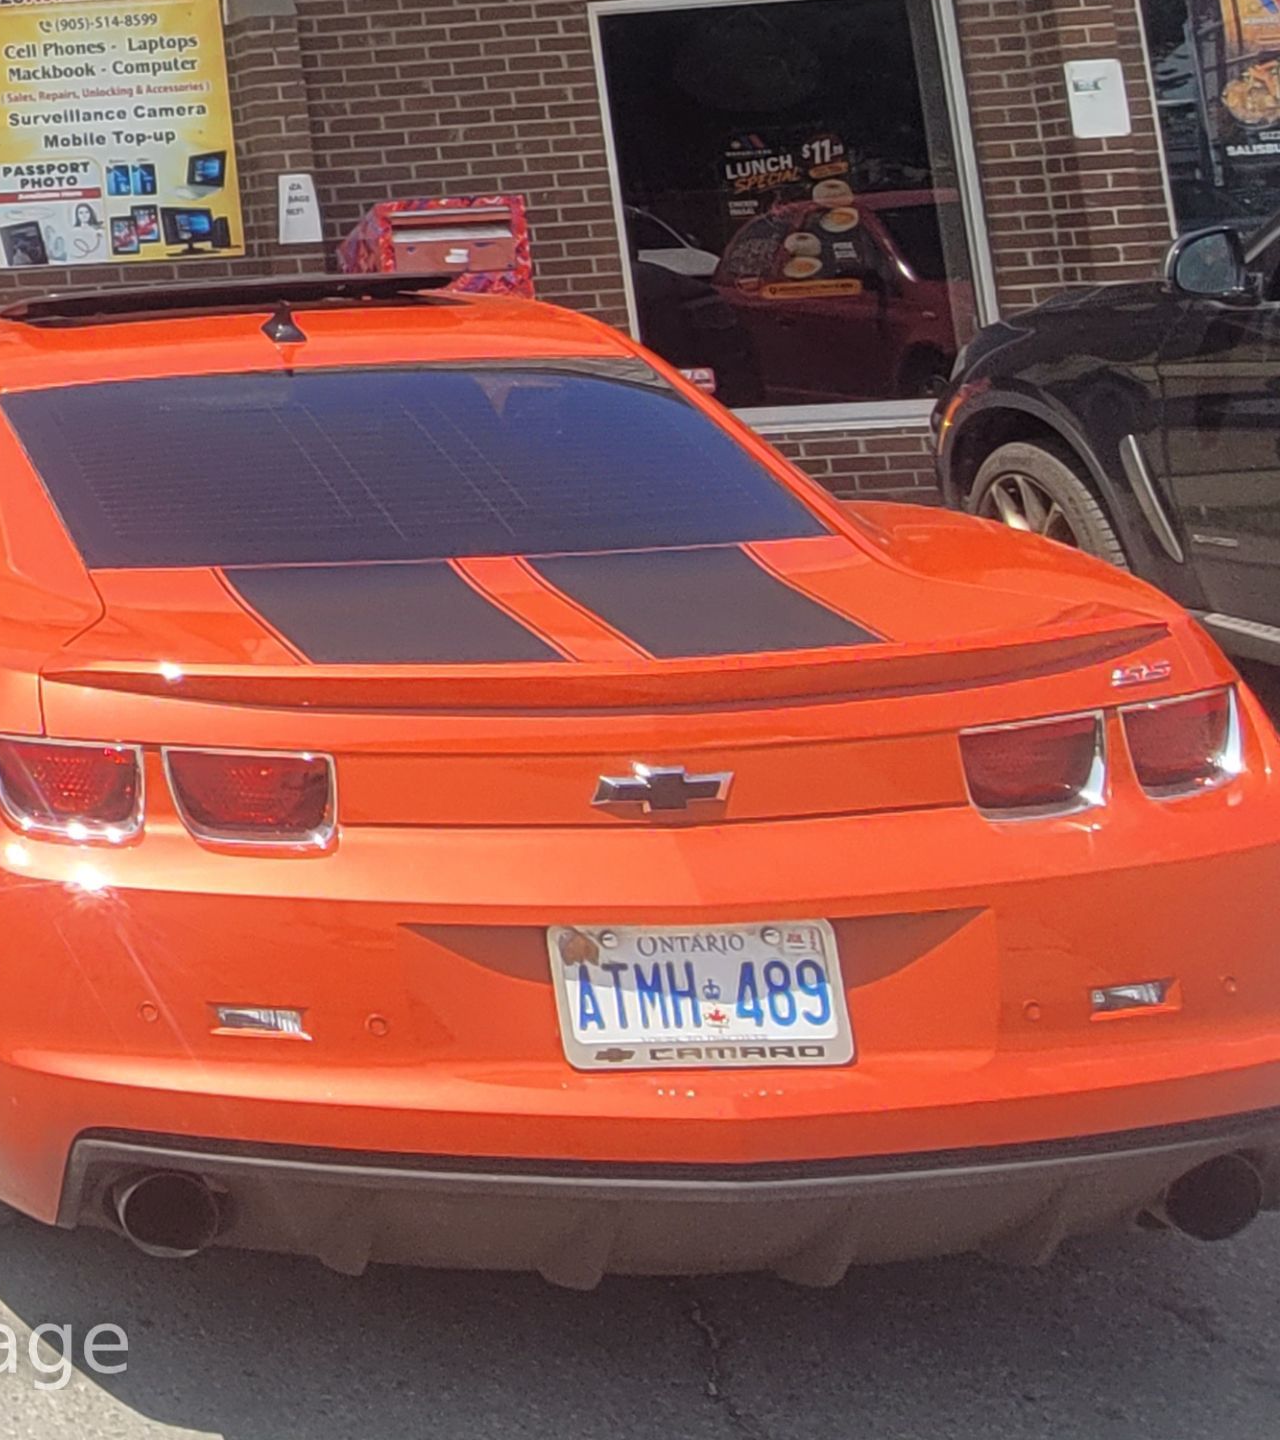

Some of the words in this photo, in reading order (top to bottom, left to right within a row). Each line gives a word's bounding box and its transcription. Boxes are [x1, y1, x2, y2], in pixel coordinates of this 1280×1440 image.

[55, 13, 158, 33] (905)-514-8599
[4, 44, 37, 59] Cell
[43, 40, 106, 57] Phones
[127, 35, 198, 54] Laptops
[8, 60, 96, 82] Mackbook
[112, 57, 198, 77] Computer
[82, 86, 133, 100] Unlocking
[146, 82, 204, 95] Accessories
[9, 106, 127, 127] Surveillance
[133, 103, 206, 119] Camera
[44, 132, 107, 148] Mobile
[112, 129, 176, 146] Top-up
[2, 162, 90, 178] PASSPORT
[725, 154, 793, 179] LUNCH
[20, 175, 78, 189] PHOTO
[734, 166, 801, 192] SPECIAL
[636, 933, 746, 956] ONTARIO
[578, 961, 703, 1031] ATMH
[736, 959, 831, 1027] 489
[650, 1045, 825, 1061] CAMARO
